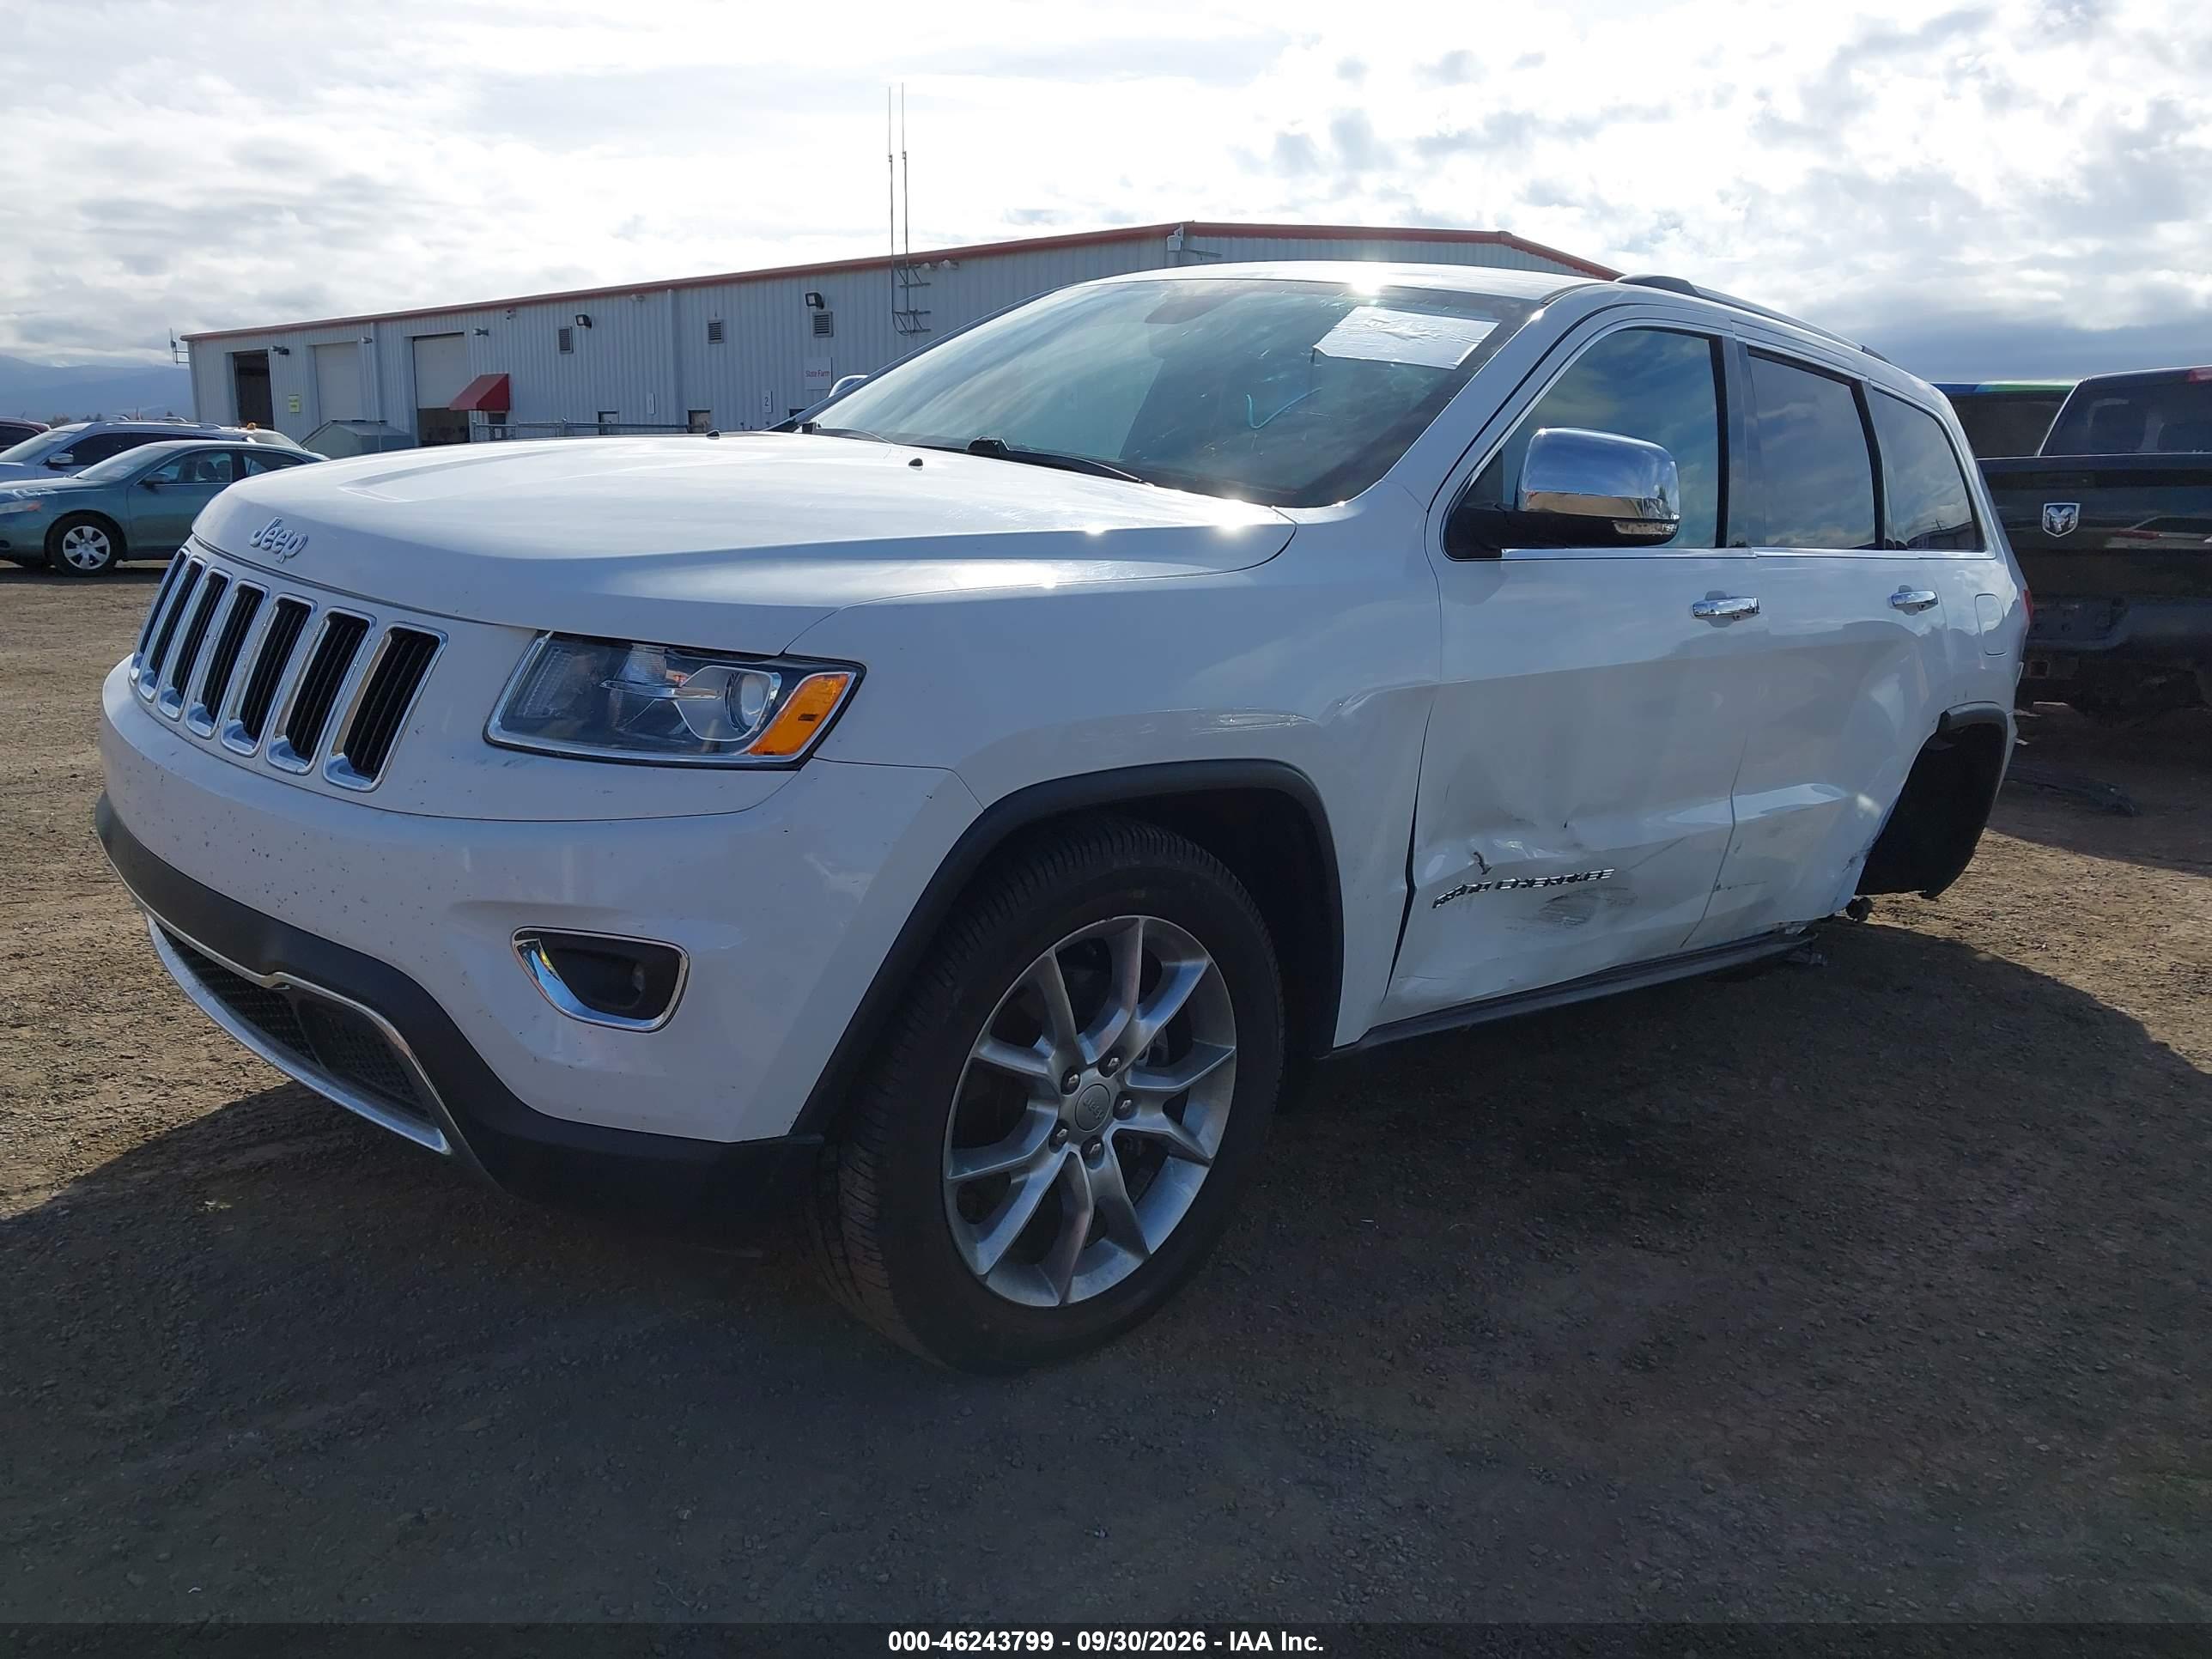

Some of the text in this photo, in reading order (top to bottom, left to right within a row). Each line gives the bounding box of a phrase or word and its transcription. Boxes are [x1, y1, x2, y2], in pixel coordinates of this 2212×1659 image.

[764, 396, 770, 407] 2
[249, 516, 308, 564] Jeep
[1495, 868, 1615, 890] CHEROKEE
